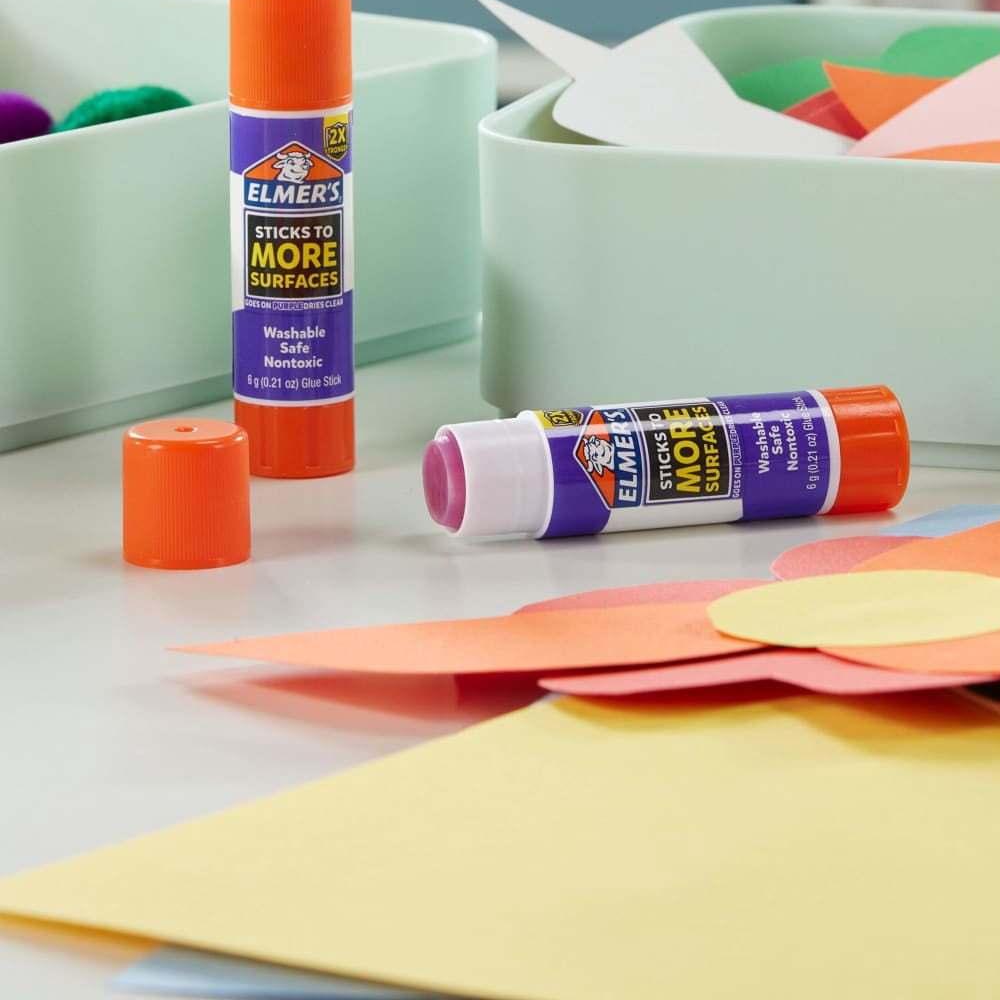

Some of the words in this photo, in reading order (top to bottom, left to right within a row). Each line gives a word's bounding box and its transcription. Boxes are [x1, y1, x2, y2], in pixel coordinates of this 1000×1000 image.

[330, 127, 346, 144] 2X
[248, 181, 340, 204] ELMER'S
[255, 225, 311, 239] STICKS
[313, 225, 333, 238] TO
[251, 242, 337, 270] MORE
[250, 271, 338, 288] SURFACES
[261, 301, 272, 309] ON
[263, 326, 326, 339] Washable
[280, 342, 310, 354] Safe
[264, 356, 323, 368] Nontoxic
[247, 374, 252, 385] 6
[253, 377, 259, 388] g
[260, 376, 281, 389] (0.21
[285, 378, 299, 390] oz)
[301, 377, 321, 388] Glue
[323, 374, 341, 387] Stick
[648, 413, 665, 430] TO
[751, 412, 770, 474] Washable
[769, 425, 783, 455] Safe
[780, 412, 799, 472] Nontoxic
[807, 433, 818, 447] oz)
[607, 411, 638, 502] ELMER'S
[662, 408, 701, 493] MORE
[691, 406, 721, 493] SURFACES
[654, 431, 673, 490] STICKS
[807, 450, 820, 473] (0.21
[734, 467, 741, 478] ON
[809, 474, 820, 482] g
